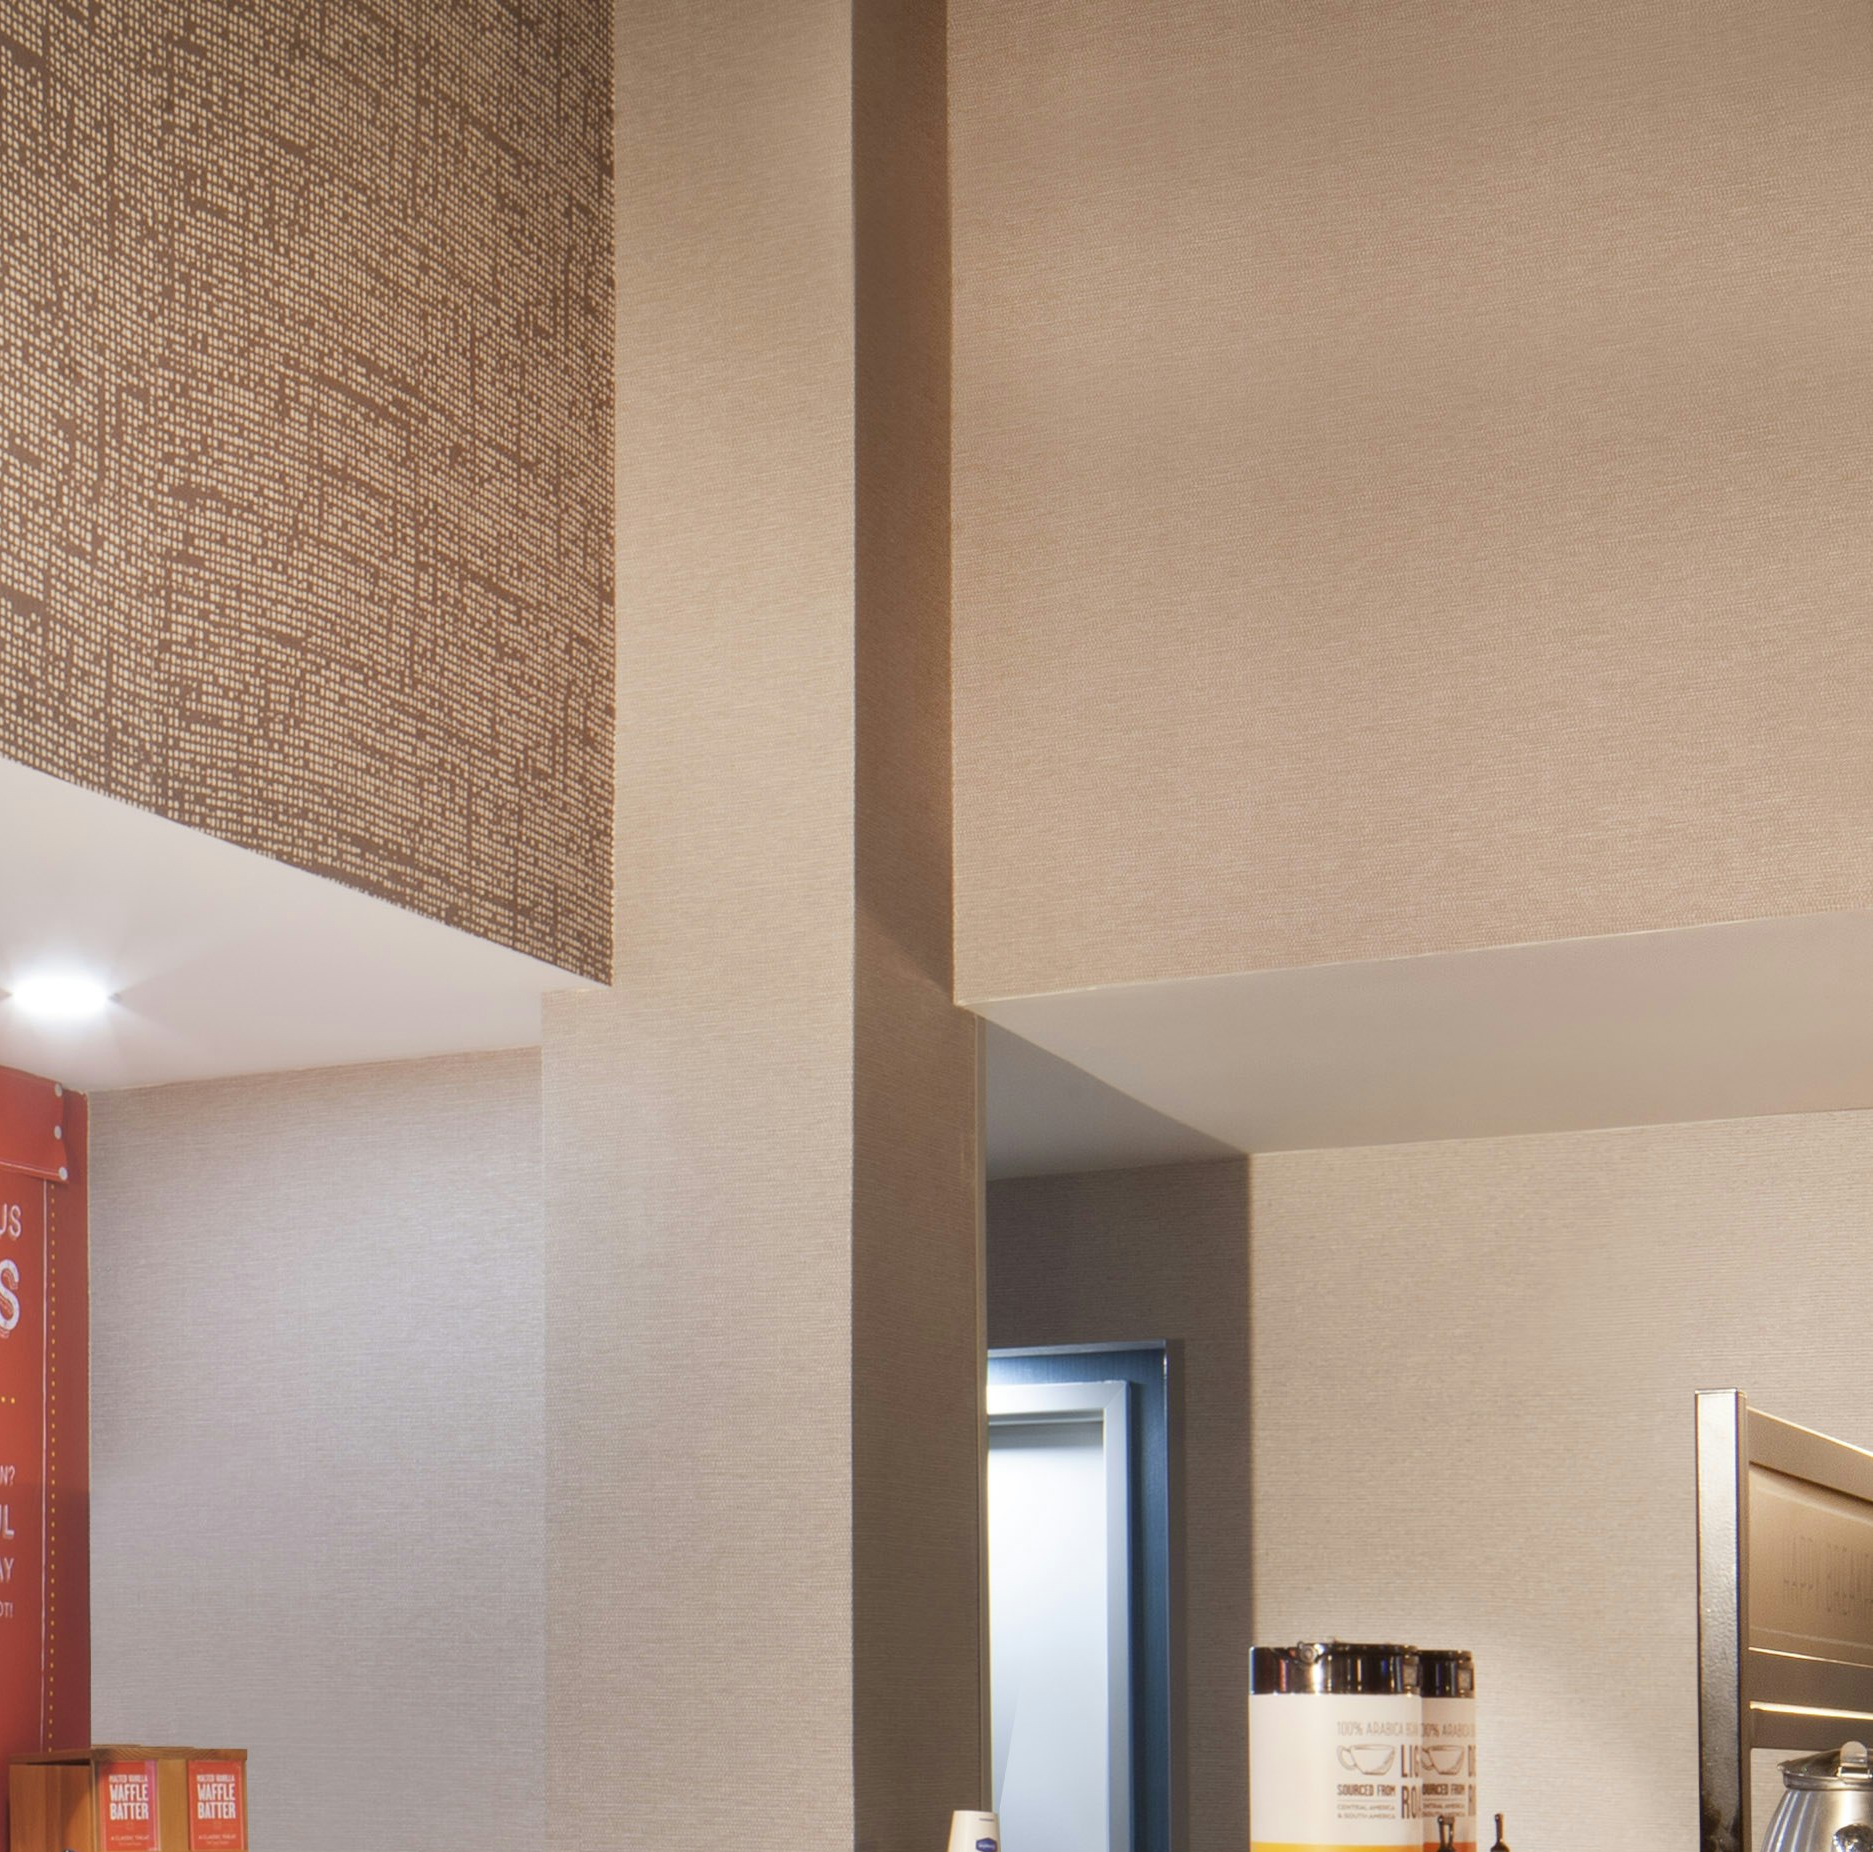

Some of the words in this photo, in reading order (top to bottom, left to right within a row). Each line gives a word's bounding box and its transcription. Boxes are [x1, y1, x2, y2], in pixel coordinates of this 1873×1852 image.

[1366, 1721, 1404, 1736] ARABICA
[110, 1783, 149, 1801] WAFFLE
[197, 1783, 235, 1801] WAFFLE
[1337, 1783, 1374, 1796] SOURCED
[1377, 1784, 1395, 1796] FROM
[1422, 1783, 1448, 1795] OURCED
[110, 1802, 149, 1820] BATTER
[198, 1801, 236, 1819] BATTER
